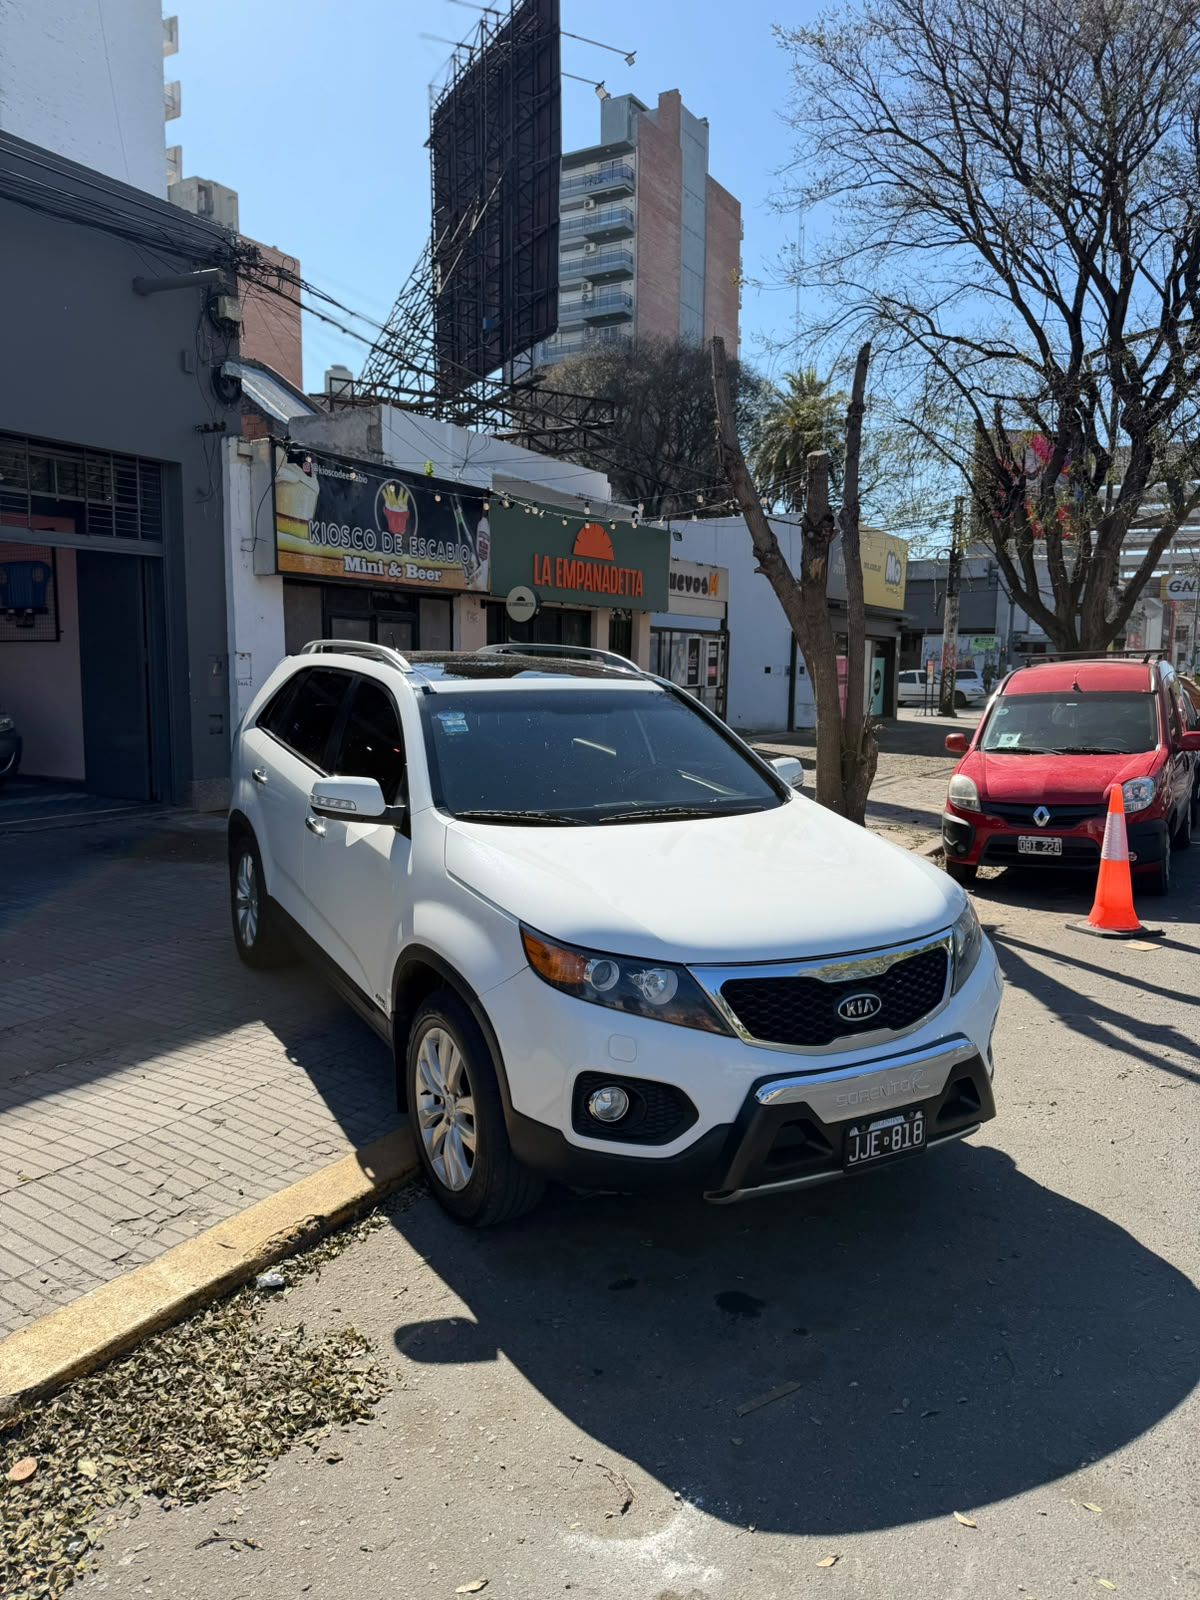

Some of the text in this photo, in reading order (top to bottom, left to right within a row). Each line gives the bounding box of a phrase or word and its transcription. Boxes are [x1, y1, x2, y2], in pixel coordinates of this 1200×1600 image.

[308, 520, 377, 550] KIOSCO
[381, 532, 403, 556] DE
[409, 537, 472, 565] ESCABIO
[343, 556, 442, 582] Mini & Beer
[533, 553, 644, 598] LA EMPANADETTA
[1168, 579, 1200, 593] GN
[846, 999, 874, 1016] KIA
[848, 1131, 881, 1162] JJE
[892, 1120, 923, 1151] 818
